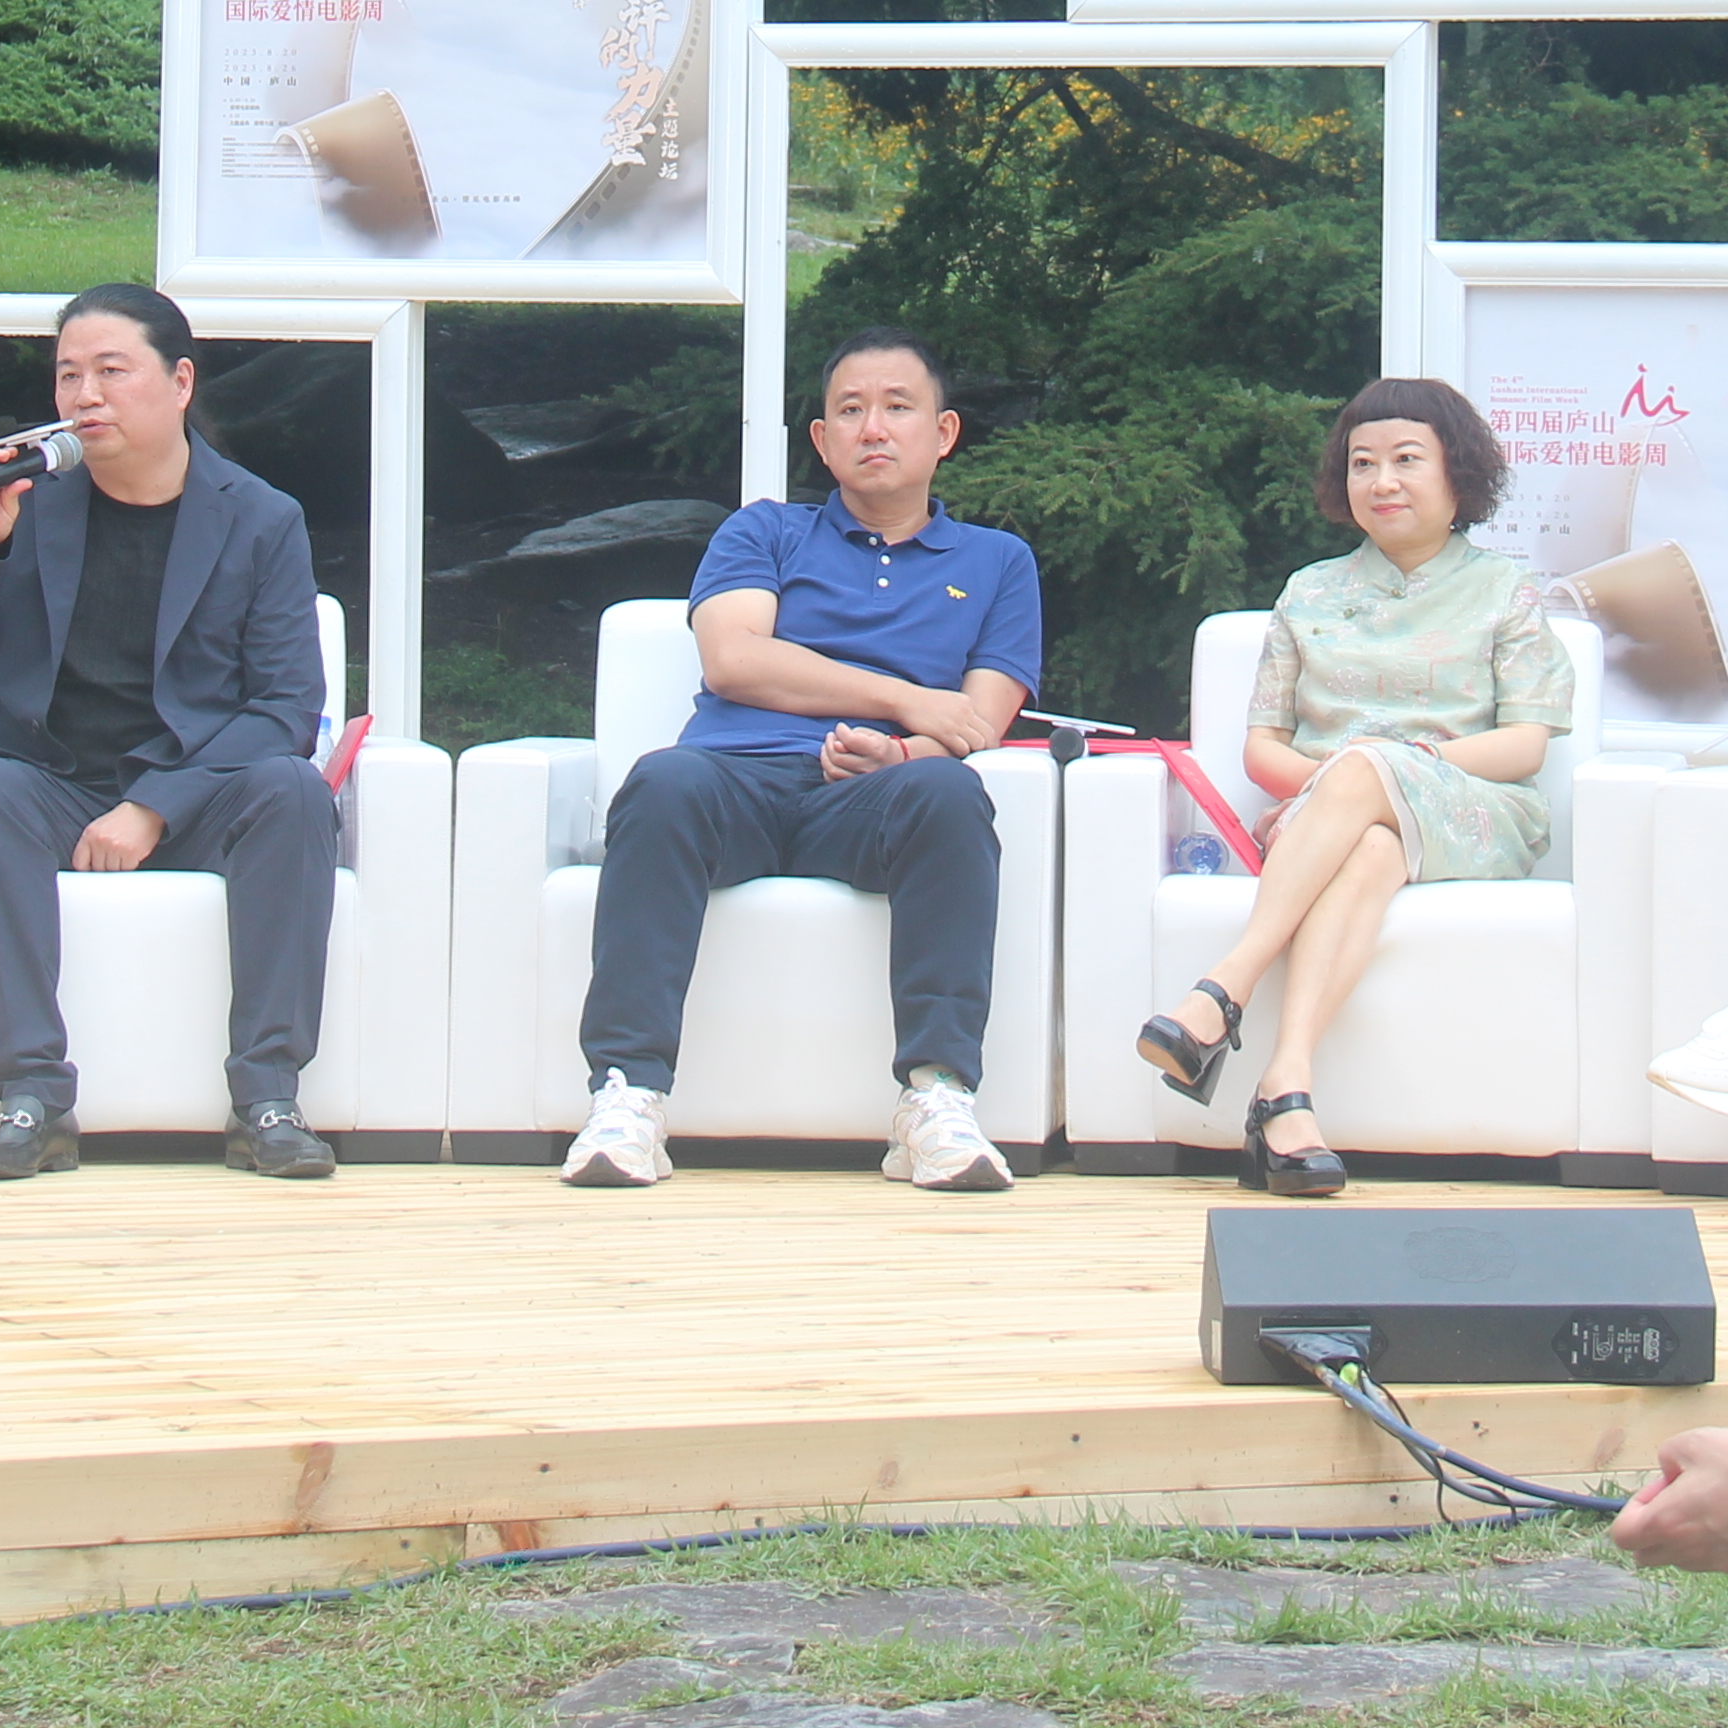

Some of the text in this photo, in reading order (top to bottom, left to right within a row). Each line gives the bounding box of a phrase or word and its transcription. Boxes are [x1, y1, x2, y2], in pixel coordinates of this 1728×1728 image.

[225, 0, 383, 23] 国际爱情电影周
[658, 97, 679, 180] 主题论坛
[1490, 376, 1507, 384] The
[1490, 386, 1588, 395] Lushan International
[1531, 396, 1552, 404] Film
[1555, 396, 1579, 404] Week
[1489, 409, 1615, 435] 第四届庐山
